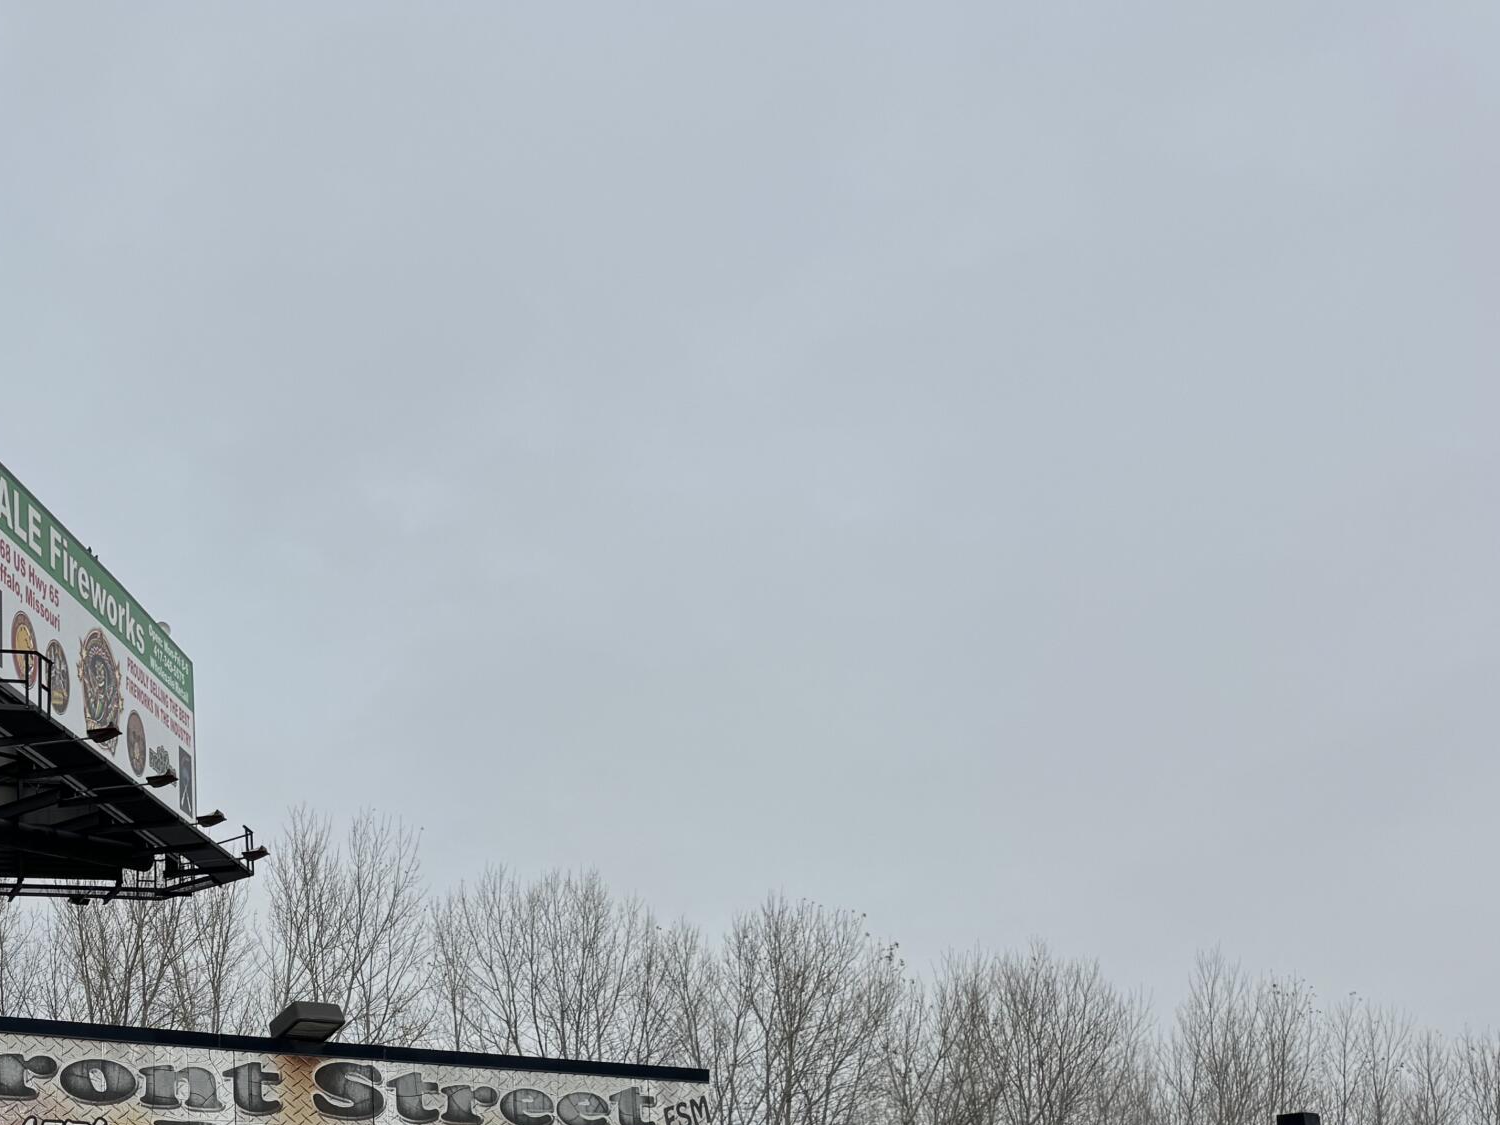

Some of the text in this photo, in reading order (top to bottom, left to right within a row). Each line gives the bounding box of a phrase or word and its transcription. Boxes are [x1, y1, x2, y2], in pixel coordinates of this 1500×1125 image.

[14, 551, 26, 577] US
[29, 564, 47, 600] Hwy
[49, 583, 60, 608] 65
[50, 525, 146, 655] Fireworks
[25, 585, 61, 632] Missouri
[169, 697, 179, 718] THE
